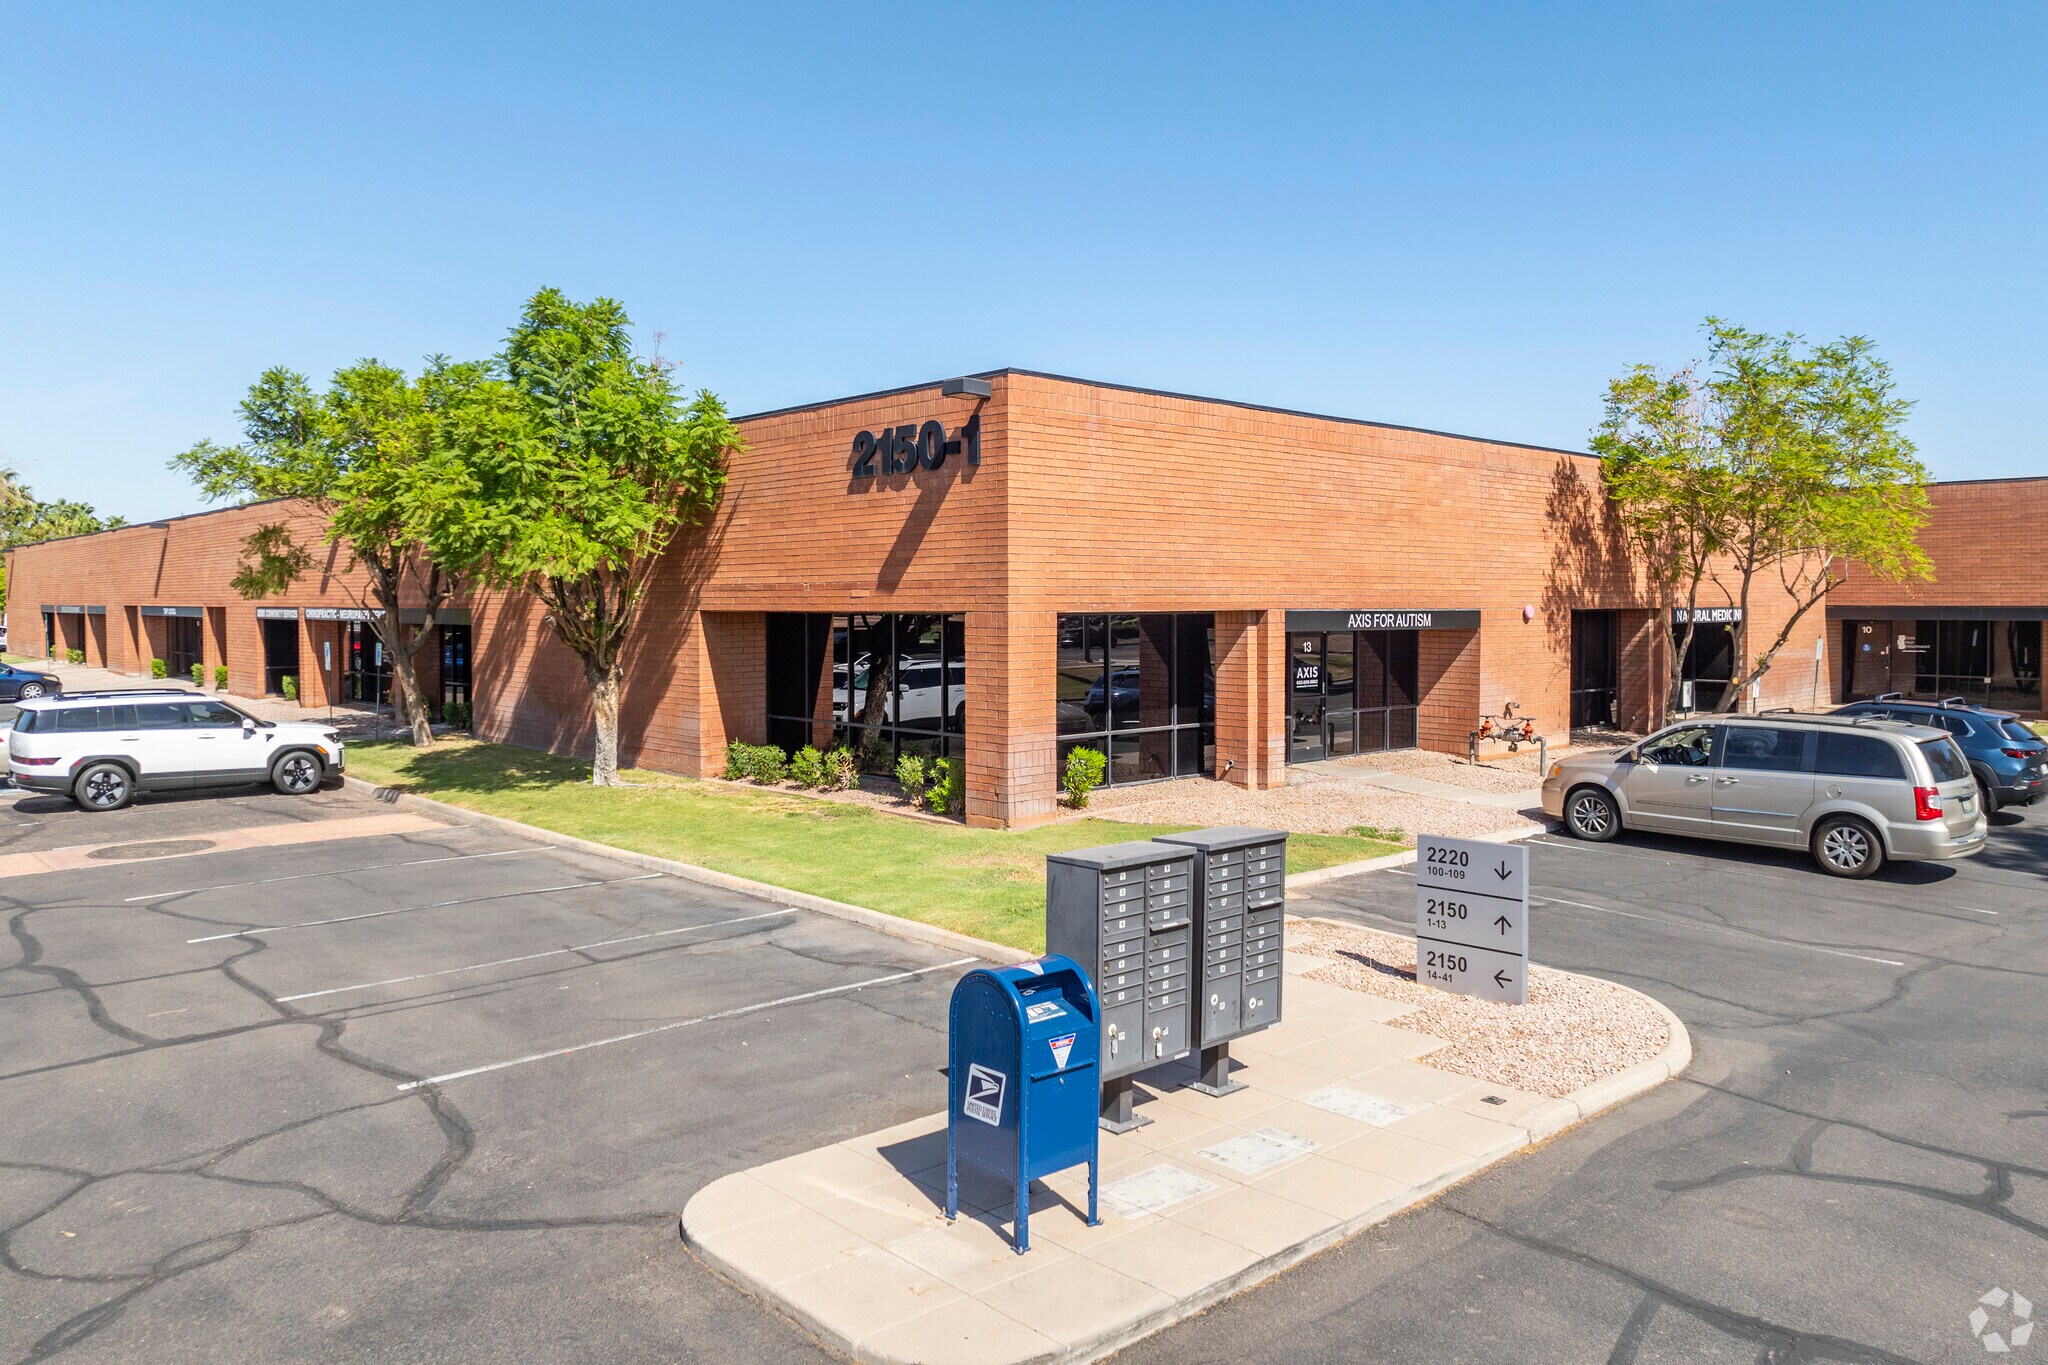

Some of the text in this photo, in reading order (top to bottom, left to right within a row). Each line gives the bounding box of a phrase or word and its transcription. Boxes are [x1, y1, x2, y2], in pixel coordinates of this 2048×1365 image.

[853, 414, 980, 478] 2150-1
[306, 609, 336, 619] CHIROPRACTIC
[1348, 614, 1431, 628] AXIS FOR AUTISM
[1676, 609, 1711, 622] NAURAL
[1303, 642, 1312, 652] 13
[1296, 666, 1318, 679] AXIS
[1427, 847, 1469, 866] 2220
[1427, 866, 1465, 880] 100-109
[1427, 899, 1467, 919] 2150
[1427, 918, 1447, 929] 1-13
[1426, 951, 1467, 972] 2150
[1427, 970, 1453, 983] 14-41
[967, 1106, 997, 1122] POSTAL SERVICE
[968, 1101, 997, 1116] UNITED STATES
